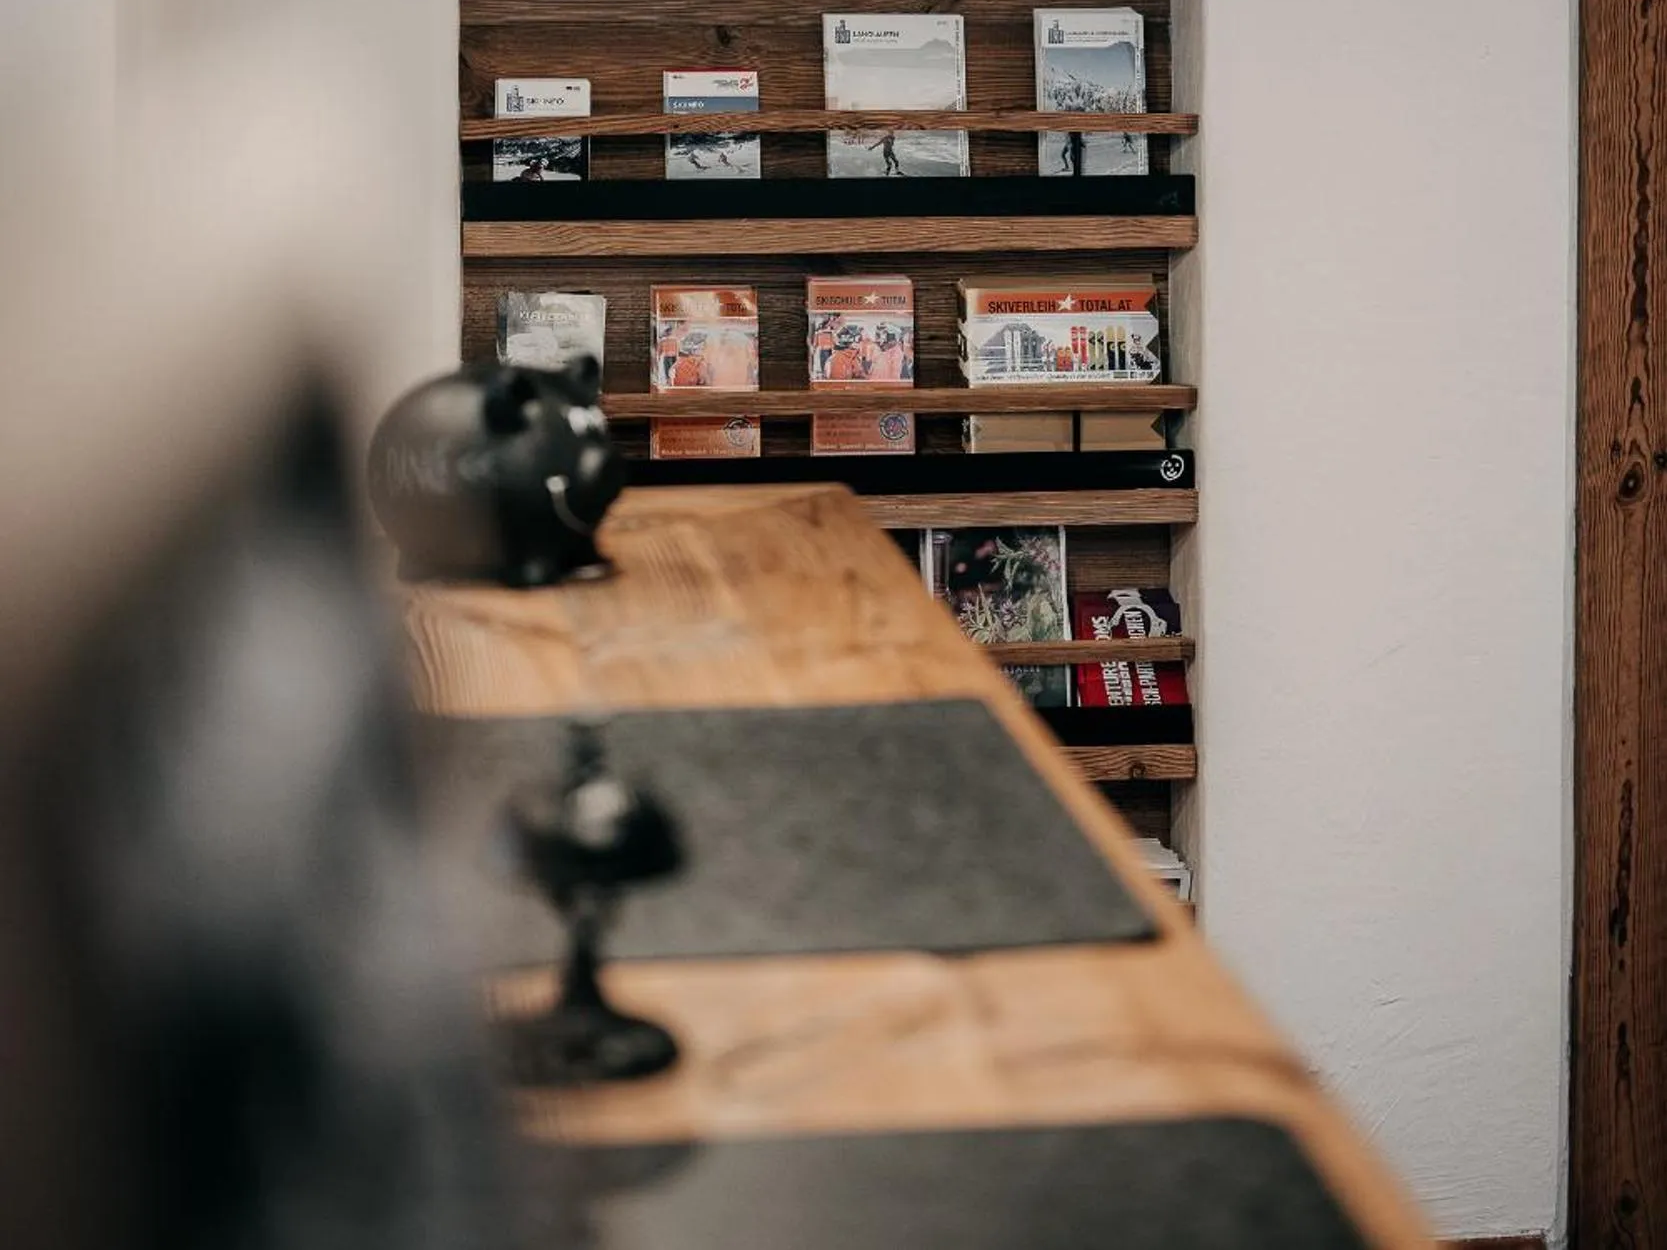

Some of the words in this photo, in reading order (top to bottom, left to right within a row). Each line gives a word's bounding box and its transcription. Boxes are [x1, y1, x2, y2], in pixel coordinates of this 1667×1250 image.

[988, 299, 1057, 314] SKIVERLEIH
[1080, 299, 1133, 313] TOTAL.AT
[1101, 661, 1124, 706] ENTURE
